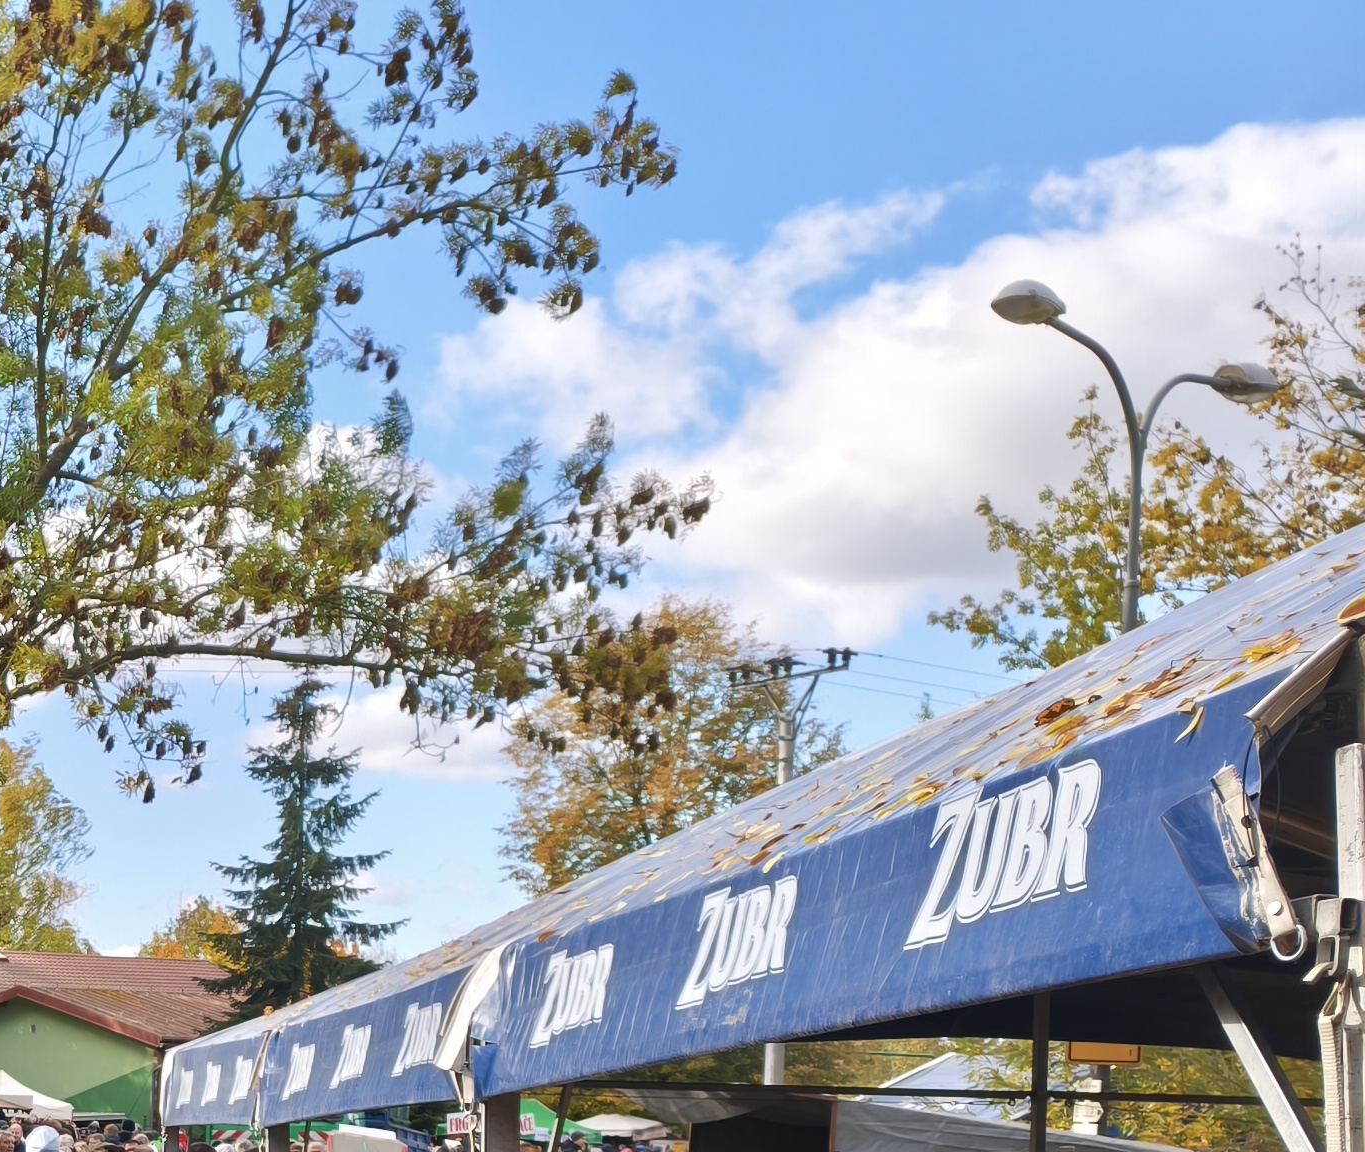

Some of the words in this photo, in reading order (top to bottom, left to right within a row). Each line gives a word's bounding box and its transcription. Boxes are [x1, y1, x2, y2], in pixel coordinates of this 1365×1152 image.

[903, 758, 1103, 952] ZUBR
[529, 942, 616, 1050] ZUBR
[674, 874, 799, 1012] ZUBR
